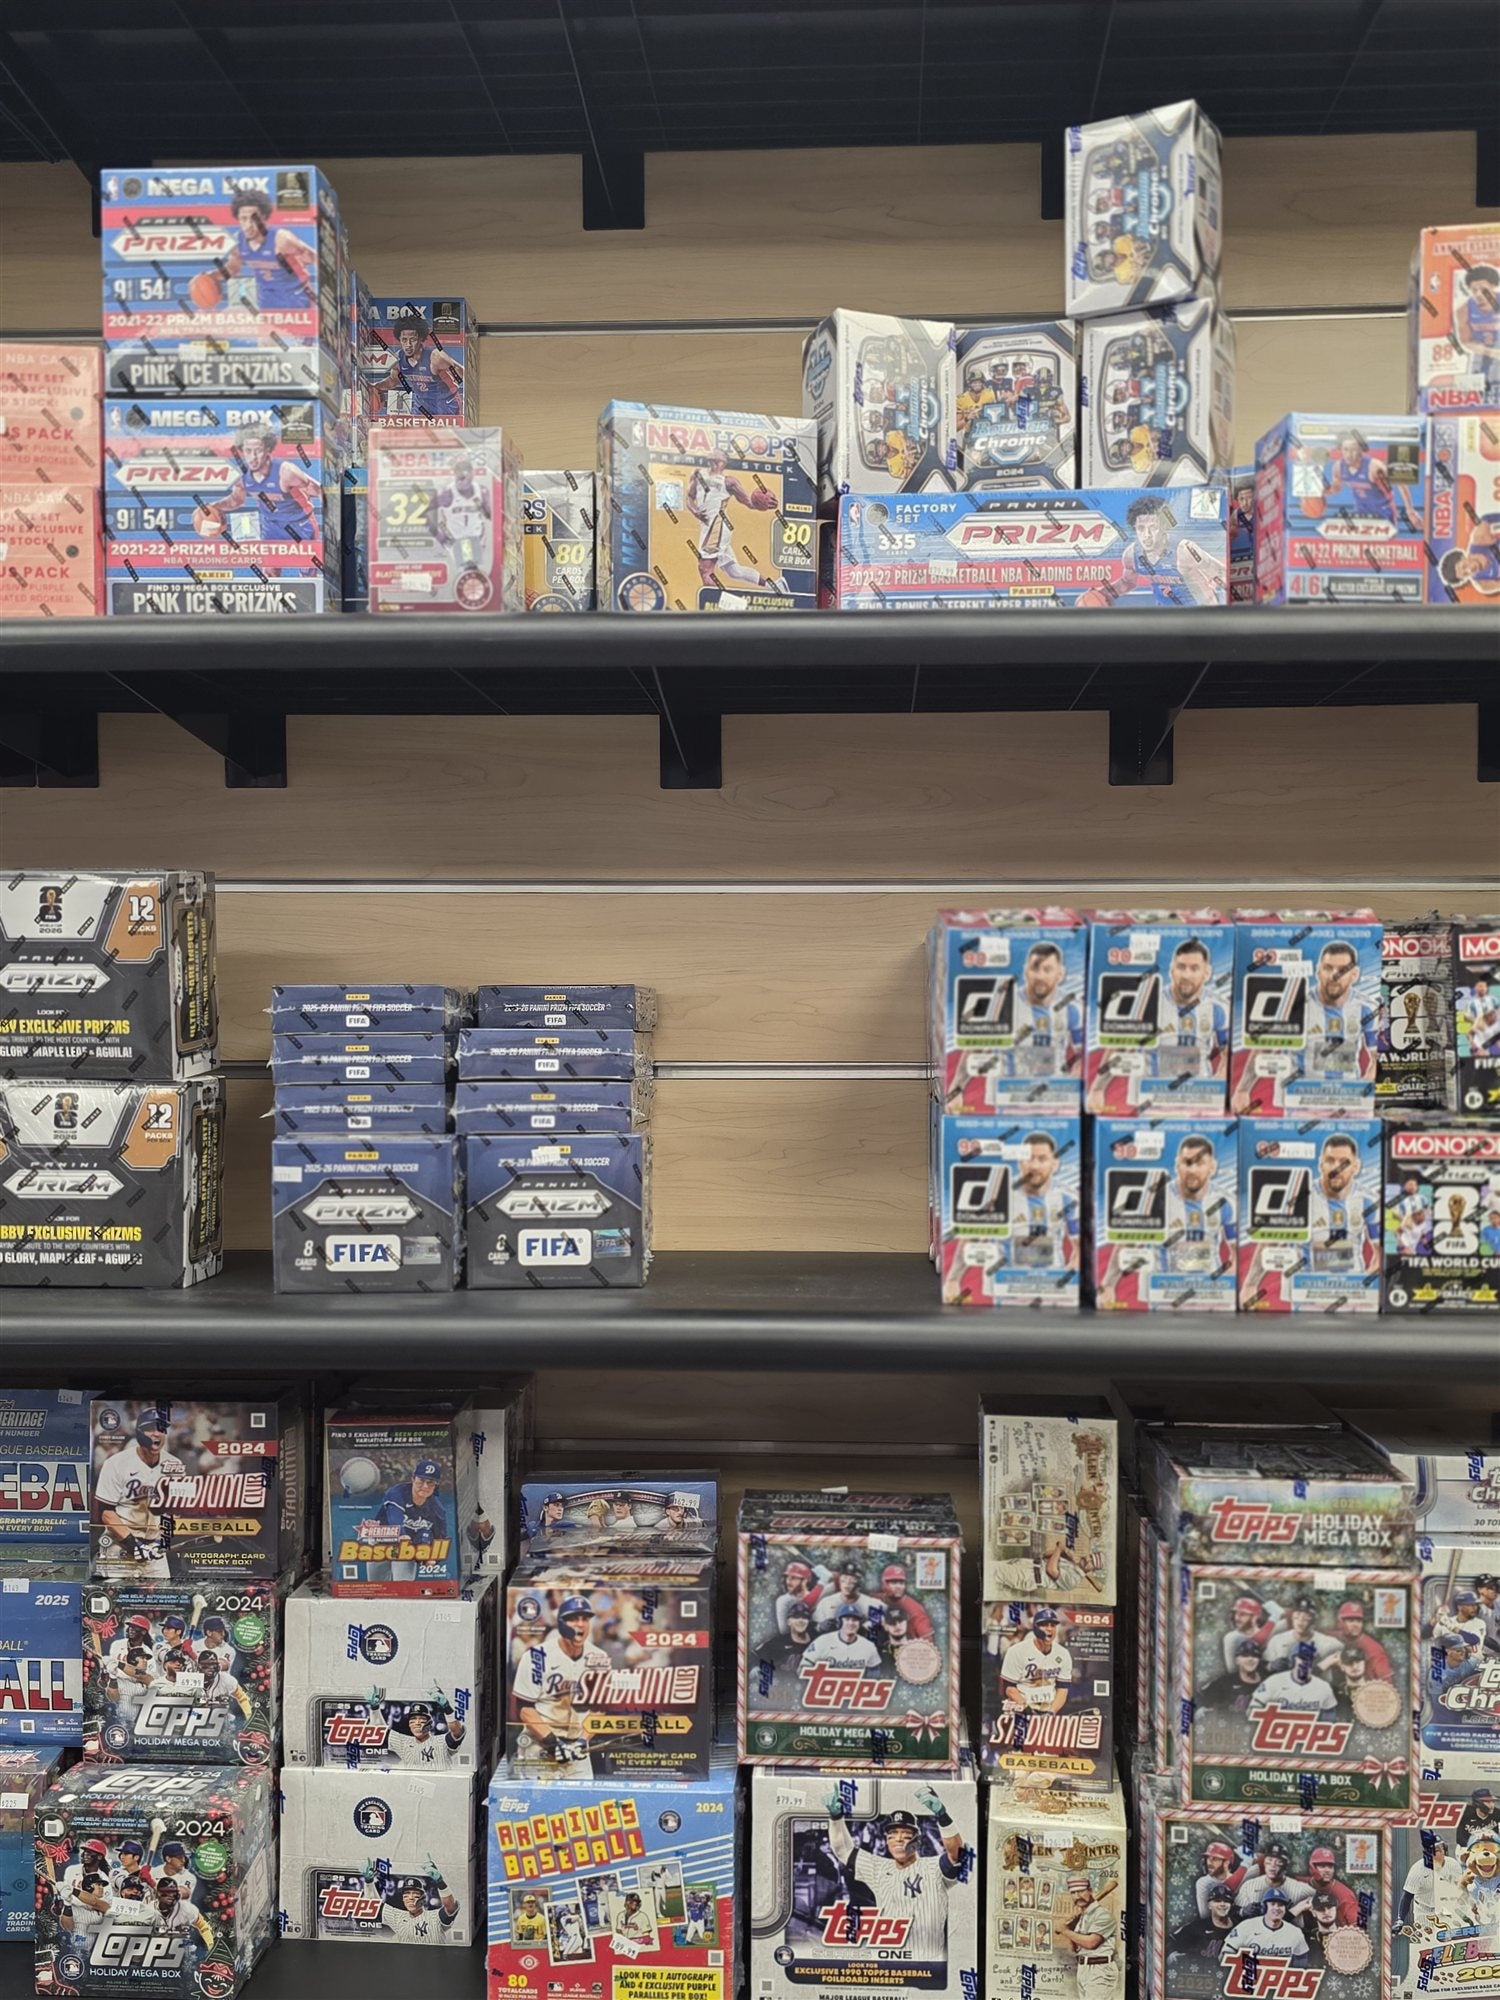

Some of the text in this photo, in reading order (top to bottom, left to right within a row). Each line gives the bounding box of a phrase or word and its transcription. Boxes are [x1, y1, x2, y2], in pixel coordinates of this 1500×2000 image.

[148, 177, 215, 196] MEGA
[123, 235, 225, 251] PRIZM
[140, 278, 164, 300] 54
[386, 305, 427, 319] BOX
[108, 312, 312, 327] 2021-22 PRIZM BASKETBALL
[131, 363, 292, 385] PINK ICE PRIZMS
[1429, 389, 1481, 407] NBA
[151, 410, 273, 427] MEGA BOX
[379, 418, 459, 428] BASKETBALL
[28, 427, 74, 440] PACK
[648, 424, 797, 460] NBA HOOPS
[974, 434, 1047, 450] Chrome
[126, 467, 229, 481] PRIZM
[742, 462, 794, 474] STOCK
[386, 493, 430, 524] 32
[896, 503, 957, 514] FACTORY
[143, 508, 168, 530] 54
[896, 514, 920, 523] SET
[783, 523, 811, 546] 80
[961, 523, 1105, 545] PRIZM
[878, 534, 917, 549] 335
[111, 544, 316, 556] 2021-22 PRIZM BASKETBALL
[556, 543, 585, 564] 80
[186, 557, 227, 565] TRADING
[778, 556, 793, 565] PER
[24, 567, 70, 578] PACK
[894, 565, 1112, 585] PRIZM NBA CARDS
[147, 584, 281, 592] FIND MEGA BOX EXCLUSIVE
[1012, 587, 1052, 596] PANINI
[186, 593, 215, 613] ICE
[129, 896, 155, 922] 12
[7, 974, 97, 986] PRIZM
[19, 1019, 82, 1034] EXCLUSIVE
[96, 1047, 133, 1058] AGUILA!
[147, 1103, 172, 1129] 12
[333, 1164, 356, 1172] PANINI
[357, 1164, 377, 1172] PRIZM
[393, 1163, 418, 1172] SOCCER
[584, 1157, 611, 1166] SOCCER
[18, 1179, 110, 1192] PRIZM
[316, 1205, 408, 1218] PRIZM
[509, 1200, 600, 1212] PRIZM
[28, 1226, 92, 1240] EXCLUSIVE
[303, 1240, 314, 1256] 8
[526, 1238, 581, 1257] FIFA
[1446, 1240, 1466, 1248] FIFA
[5, 1252, 97, 1265] GLORY, LEAF
[334, 1243, 389, 1263] FIFA
[1431, 1257, 1479, 1268] WORLD
[25, 1445, 82, 1456] BASEBALL
[217, 1442, 266, 1455] 2024
[1312, 1514, 1384, 1530] HOLIDAY
[368, 1526, 400, 1536] HERITAGE
[1303, 1530, 1391, 1547] MEGA BOX
[338, 1538, 450, 1562] Baseball
[418, 1564, 447, 1574] 2024
[35, 1595, 70, 1606] 2025
[216, 1596, 263, 1611] 2024
[1074, 1614, 1110, 1625] 2024
[646, 1633, 697, 1646] 2024
[800, 1726, 871, 1738] HOLIDAY MEGA
[134, 1738, 221, 1747] HOLIDAY MEGA BOX
[1006, 1758, 1089, 1771] BASEBALL
[1249, 1770, 1352, 1785] HOLIDAY BOX
[80, 1793, 191, 1803] HOLIDAY MEGA BOX
[696, 1802, 724, 1813] 2024
[175, 1820, 226, 1837] 2024
[497, 1800, 638, 1848] ARCHIVES
[503, 1831, 644, 1878] BASEBALL
[8, 1912, 35, 1920] 2024
[360, 1921, 383, 1929] ONE
[878, 1950, 913, 1959] ONE
[90, 1968, 181, 1978] HOLIDAY MEGA BOX
[620, 1971, 641, 1980] LOOK
[840, 1968, 862, 1976] 1990
[891, 1970, 932, 1978] BASEBALL
[508, 1974, 528, 1988] 80
[620, 1981, 717, 1992] AND EXCLUSIVE PURPLE
[822, 1976, 868, 1984] FOILBOARD
[628, 1991, 687, 2000] PARALLELS PER
